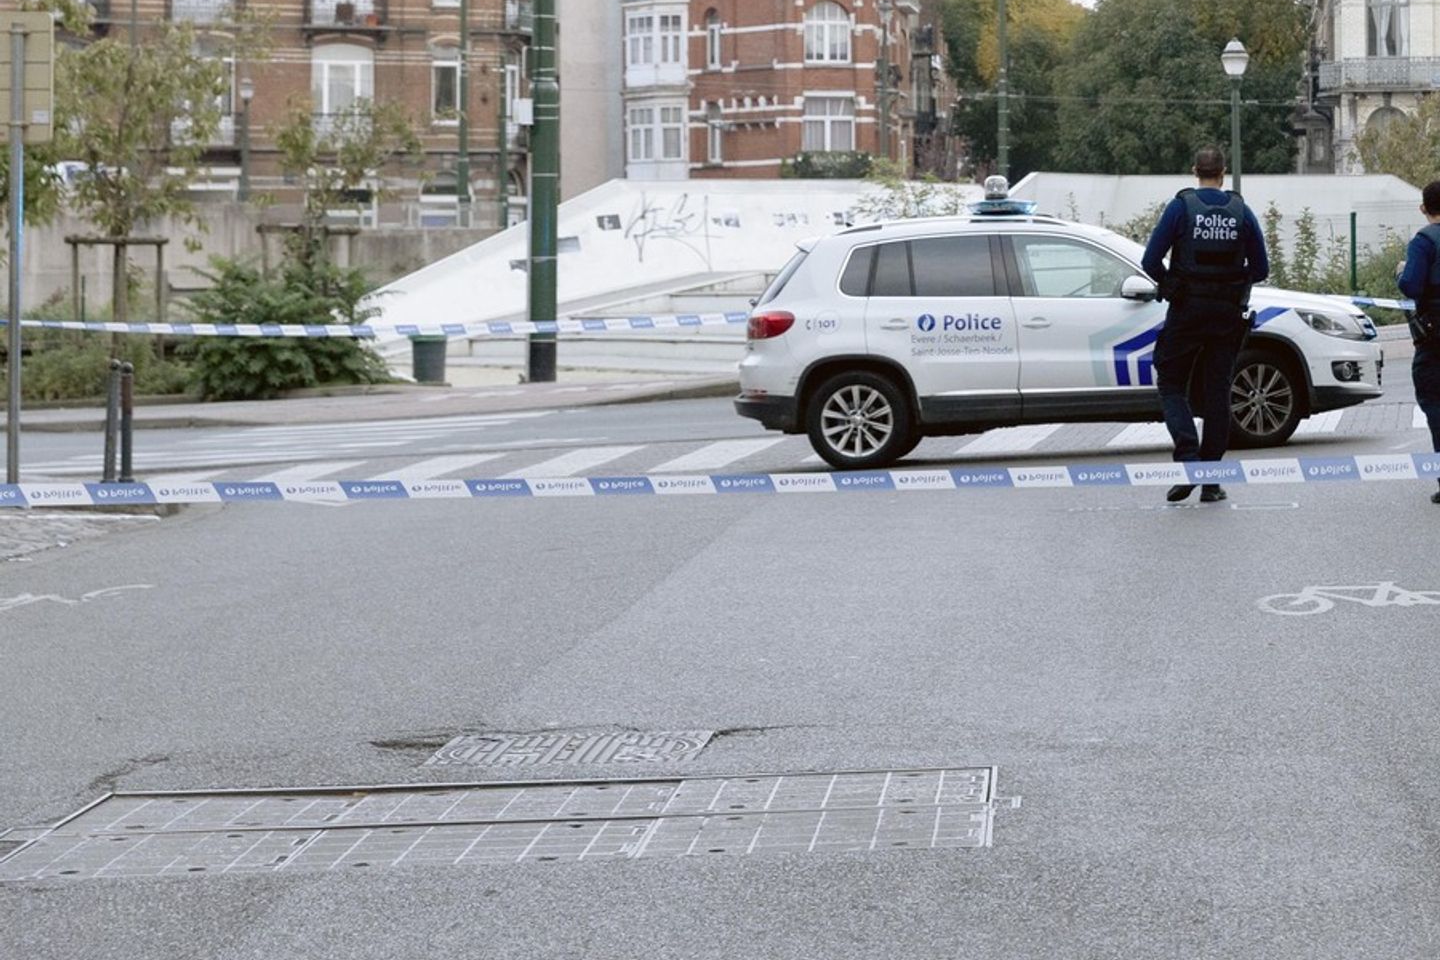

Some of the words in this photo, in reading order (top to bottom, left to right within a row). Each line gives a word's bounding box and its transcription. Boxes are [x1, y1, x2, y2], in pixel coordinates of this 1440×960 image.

[1196, 214, 1237, 227] Police
[1193, 227, 1238, 240] Politie
[818, 319, 836, 329] 101
[943, 313, 1002, 331] Police
[911, 334, 936, 343] Evere
[944, 332, 996, 343] Schaerbeek
